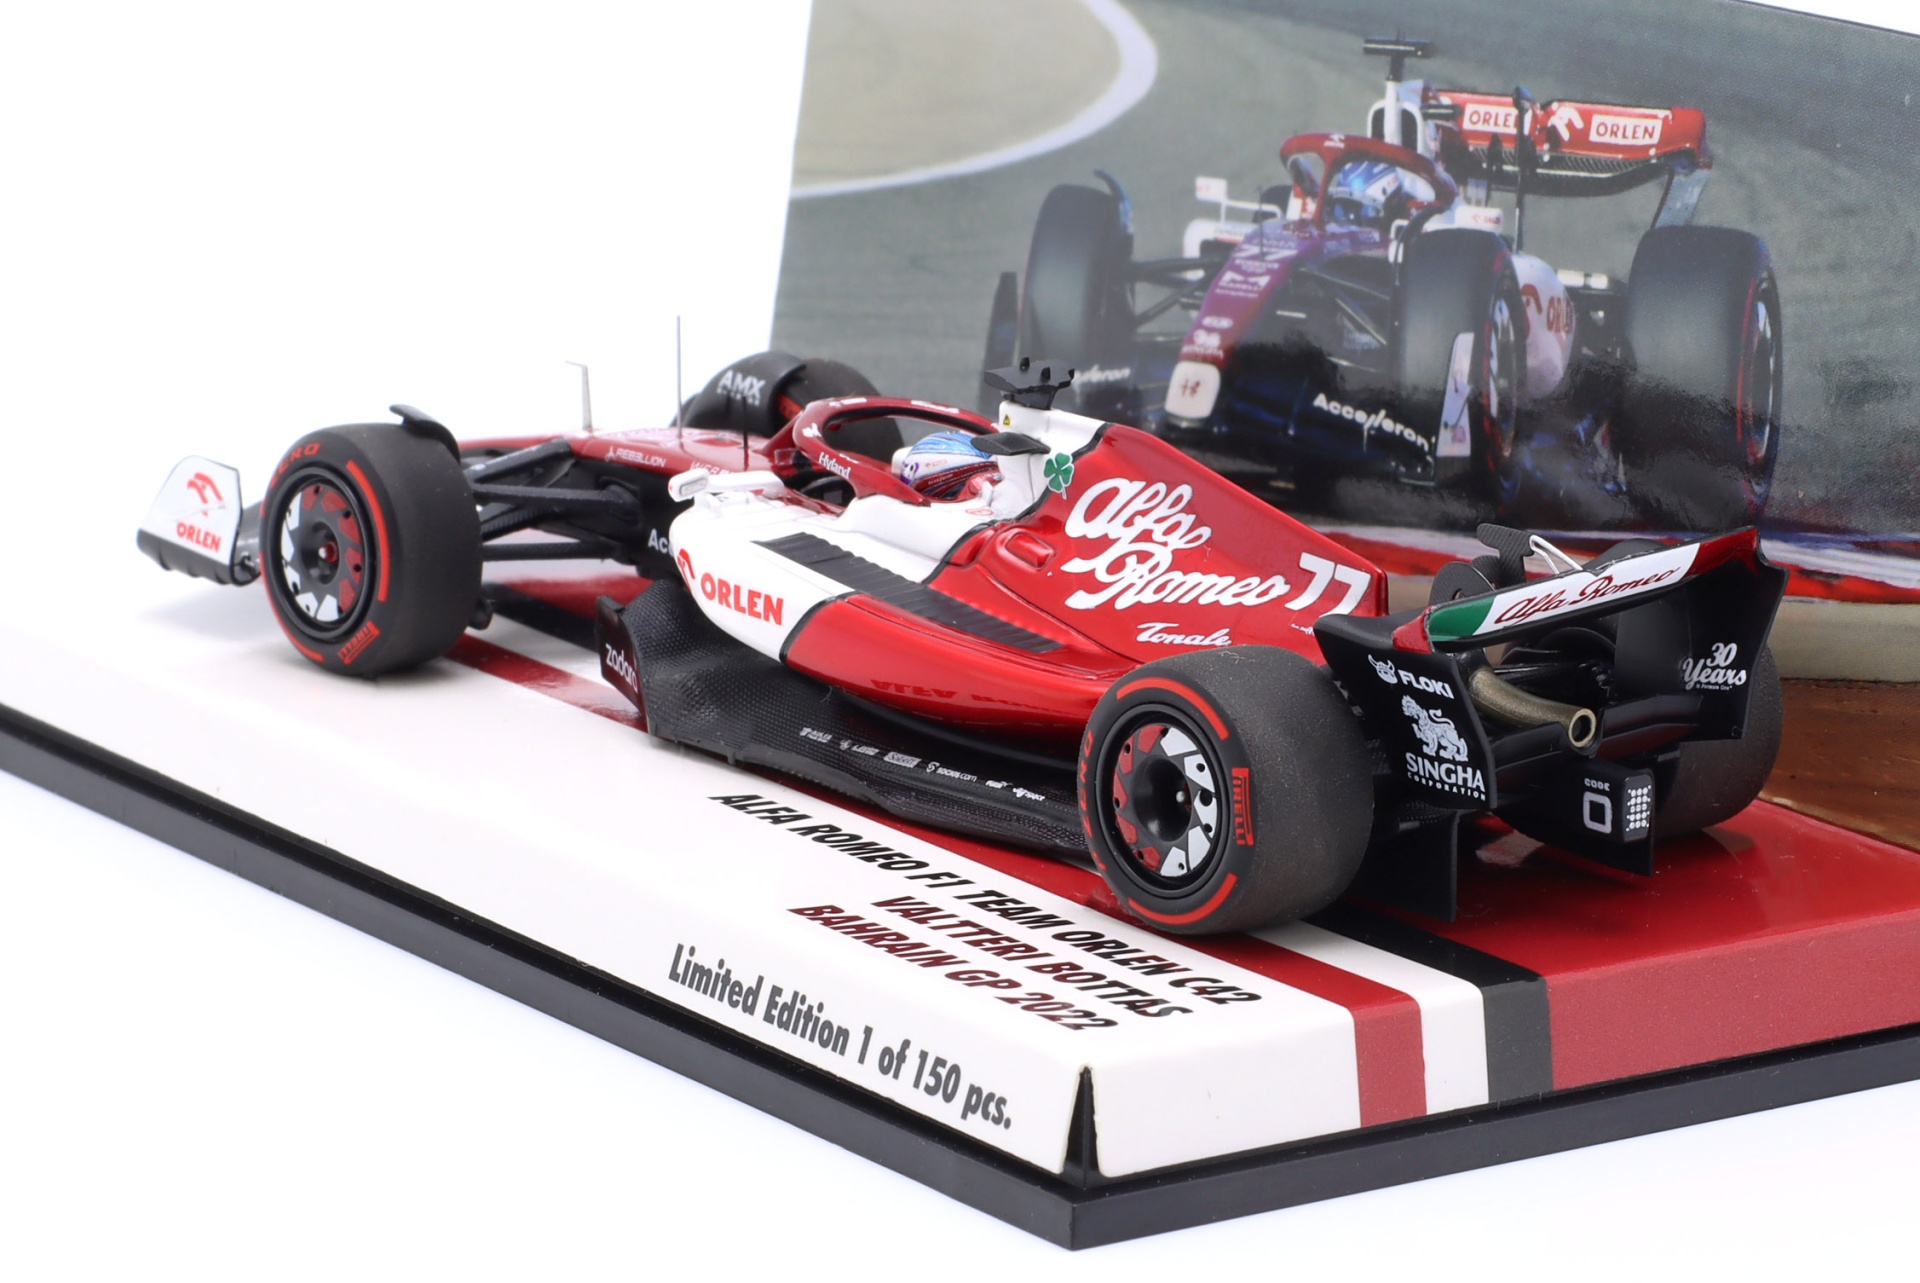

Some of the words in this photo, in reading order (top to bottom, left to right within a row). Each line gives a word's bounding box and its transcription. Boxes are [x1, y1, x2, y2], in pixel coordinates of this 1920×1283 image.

[1595, 121, 1656, 140] ORLEN
[717, 369, 766, 398] AMX
[818, 451, 852, 481] Hyland
[1065, 477, 1212, 550] Alfa
[176, 521, 222, 553] ORLEN
[1060, 541, 1291, 610] Romeo
[1284, 551, 1372, 618] 77
[701, 572, 784, 626] ORLEN
[1494, 589, 1568, 625] Alfa
[1569, 567, 1680, 606] Romeo
[1137, 622, 1232, 647] Tonale
[1682, 657, 1747, 691] Years
[1706, 642, 1738, 668] 30
[1398, 669, 1455, 699] FLOKI
[1405, 752, 1486, 792] SINGHA
[1407, 772, 1486, 801] CORPORATION
[1584, 778, 1611, 791] CODE
[1231, 766, 1255, 847] PIRELLI
[707, 794, 814, 825] ALFA
[786, 823, 930, 871] ROMEO
[904, 871, 977, 889] F1
[953, 889, 1077, 930] TEAM
[1051, 930, 1193, 976] ORLEN
[1168, 977, 1263, 1005] C42
[786, 904, 971, 968] BAHRAIN
[944, 969, 1022, 990] GP
[993, 992, 1119, 1031] 2022
[870, 895, 1056, 961] VALTTERI
[1024, 961, 1194, 1018] BOTTAS
[668, 943, 764, 1016] Limited
[762, 985, 850, 1057] Edition
[857, 1025, 873, 1065] 1
[878, 1038, 911, 1080] of
[912, 1049, 961, 1104] 150
[960, 1083, 1012, 1130] pcs.
